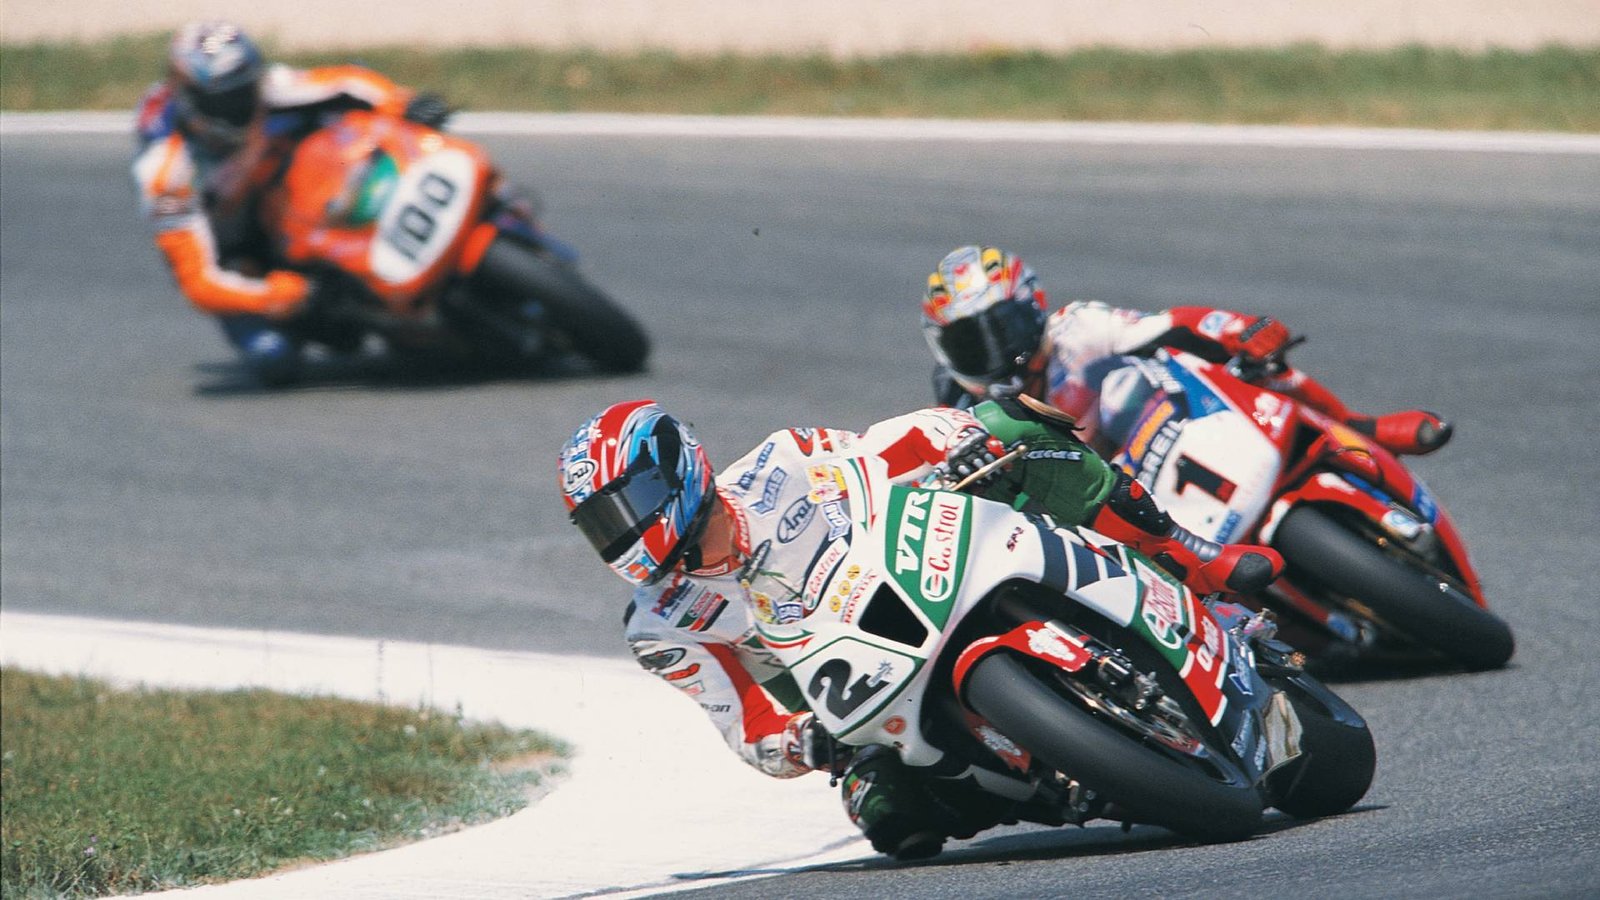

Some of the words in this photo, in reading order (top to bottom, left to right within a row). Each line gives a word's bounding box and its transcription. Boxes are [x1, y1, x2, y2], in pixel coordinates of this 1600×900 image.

[1175, 454, 1238, 504] 1
[894, 490, 932, 576] VTR
[928, 503, 961, 573] Castrol
[808, 658, 890, 720] 2
